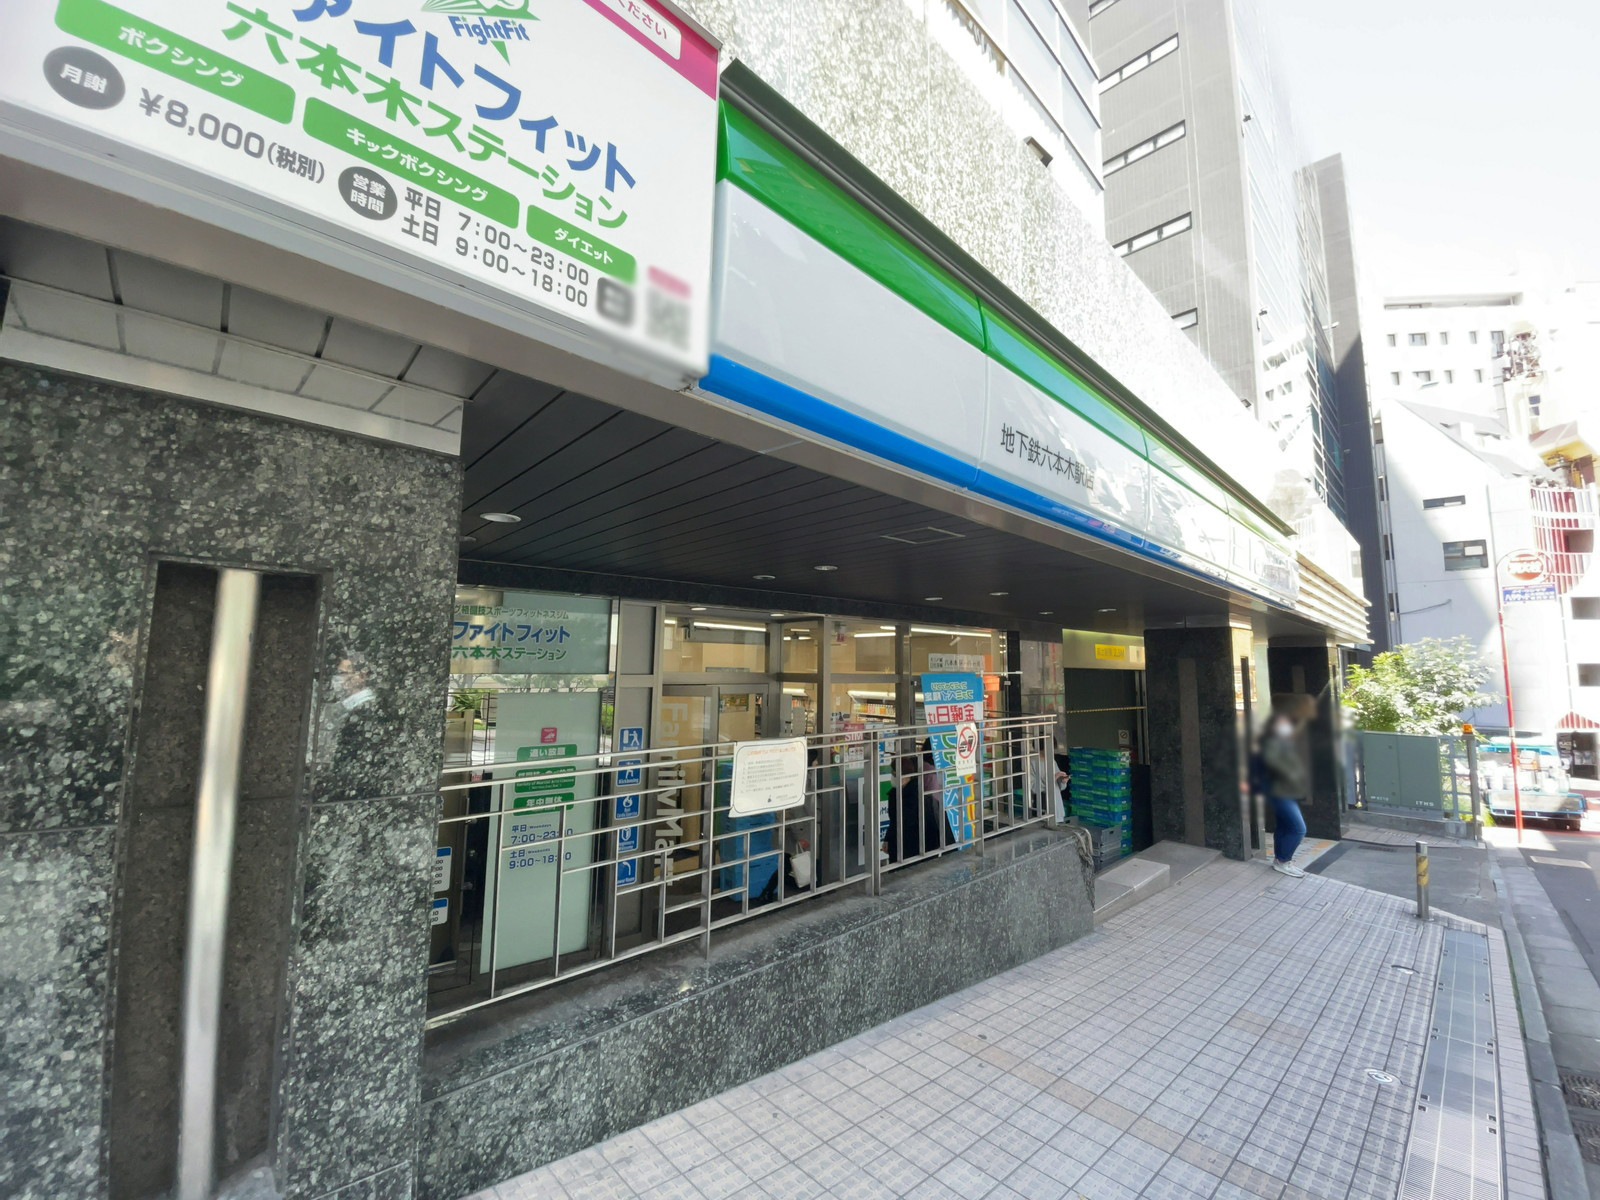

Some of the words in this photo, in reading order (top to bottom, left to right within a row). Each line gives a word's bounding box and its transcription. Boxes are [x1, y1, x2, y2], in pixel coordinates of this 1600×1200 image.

[448, 15, 531, 45] FightFit
[618, 0, 667, 39] ださい
[119, 25, 244, 88] ボクシング
[60, 64, 108, 94] 月謝
[221, 1, 628, 229] 六本木ステーション
[346, 127, 488, 202] キックボクシング
[350, 190, 384, 215] 時間
[352, 173, 386, 199] 営業
[404, 186, 442, 222] 平日
[401, 211, 439, 247] 土日
[554, 227, 613, 265] ダイエット
[1000, 423, 1095, 491] 地下鉄六本木駅店
[452, 621, 570, 643] ファイトフィット
[452, 645, 567, 660] 六本木ステーション
[512, 824, 527, 833] 平日
[510, 849, 525, 859] 土日
